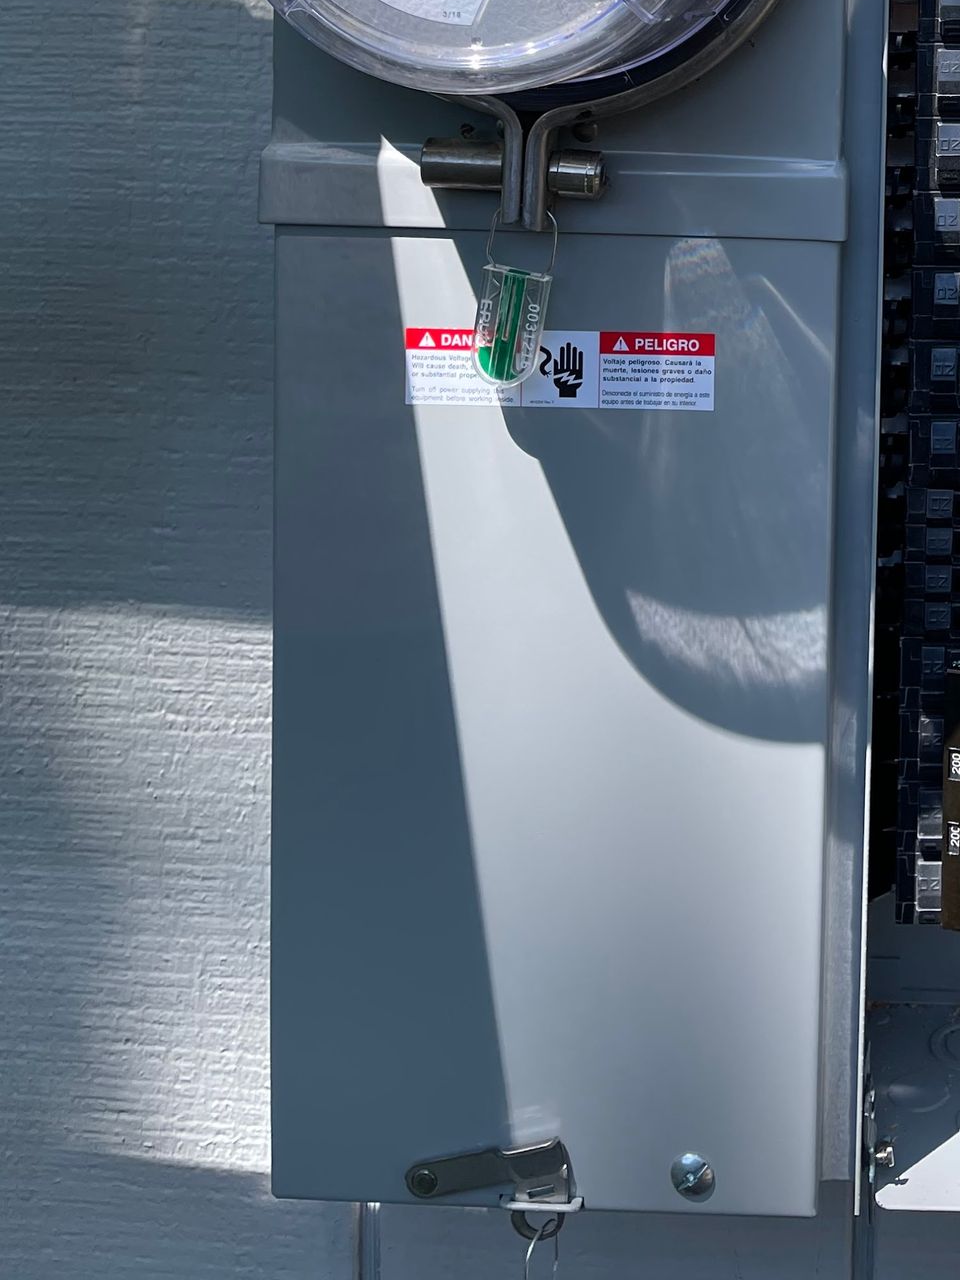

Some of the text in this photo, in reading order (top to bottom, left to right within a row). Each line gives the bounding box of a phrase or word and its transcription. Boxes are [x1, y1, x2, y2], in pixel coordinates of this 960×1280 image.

[635, 338, 699, 351] PELIGRO
[603, 358, 626, 366] Voltaje
[952, 753, 960, 775] 200
